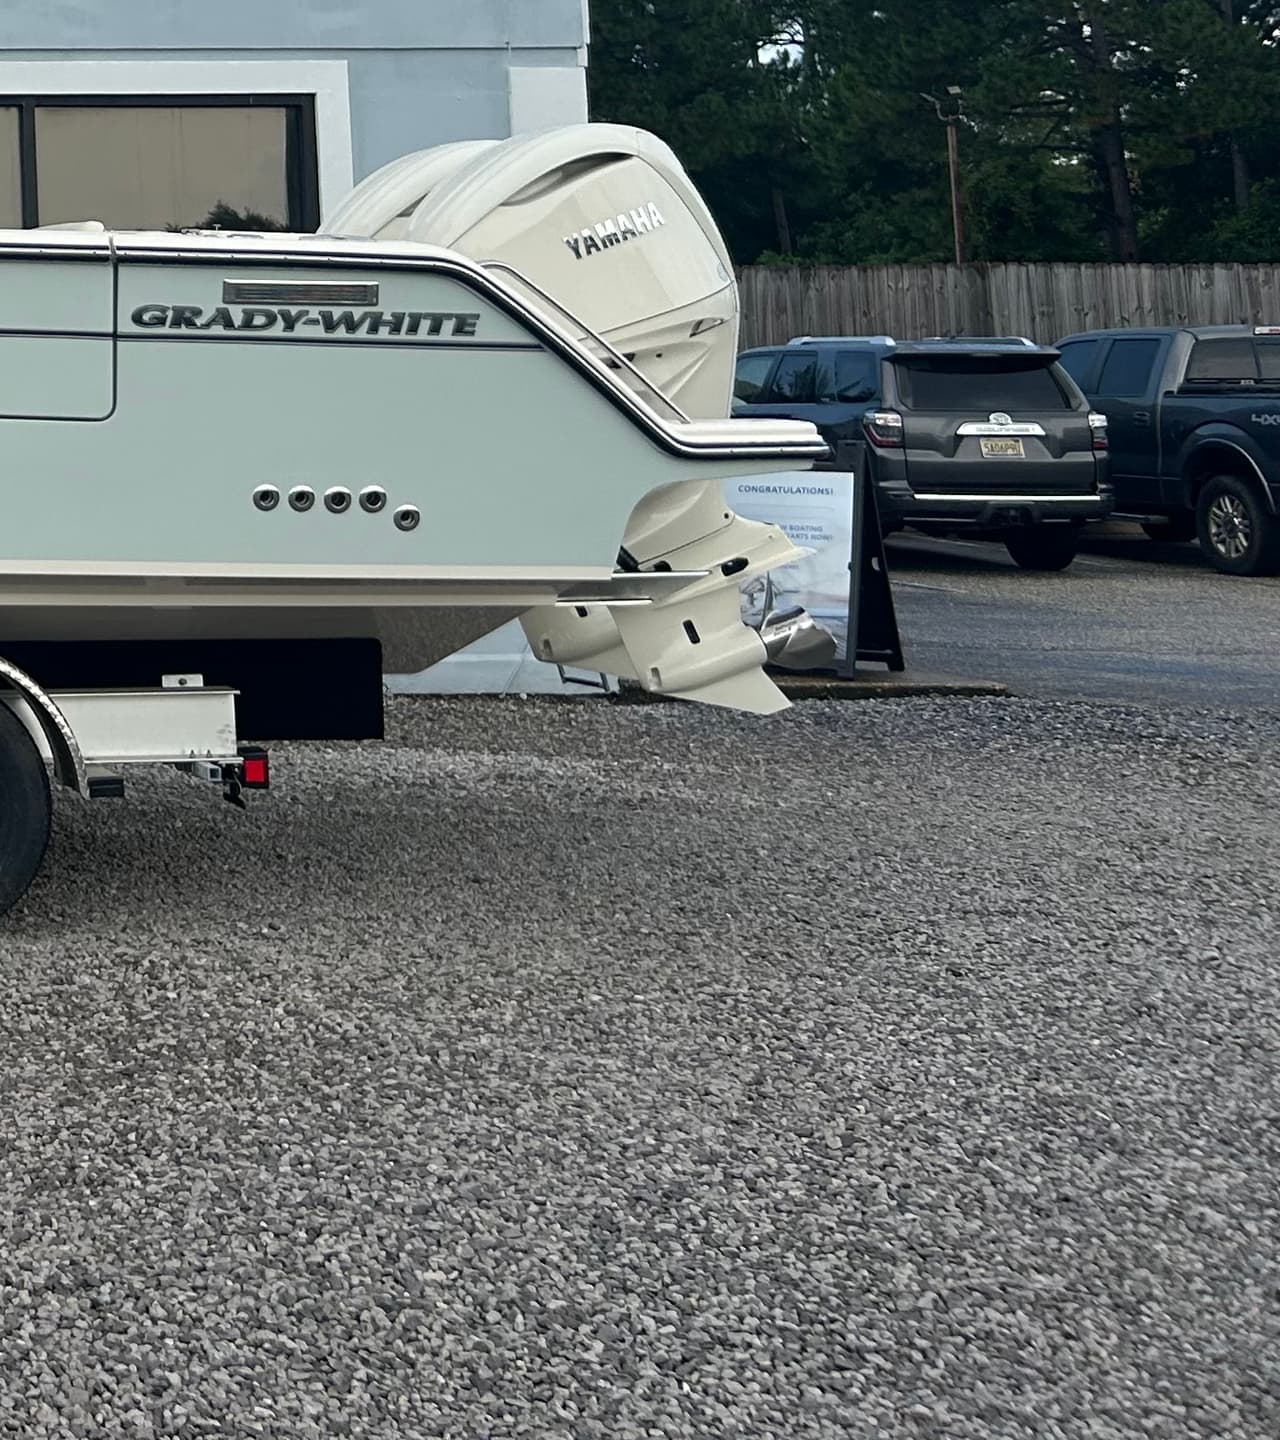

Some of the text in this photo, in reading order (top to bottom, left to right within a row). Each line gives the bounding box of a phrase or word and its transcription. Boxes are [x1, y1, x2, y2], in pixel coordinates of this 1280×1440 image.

[561, 201, 665, 260] YAMAHA
[131, 304, 480, 337] GRADY-WHITE
[737, 484, 834, 495] CONGRATULATIONS!
